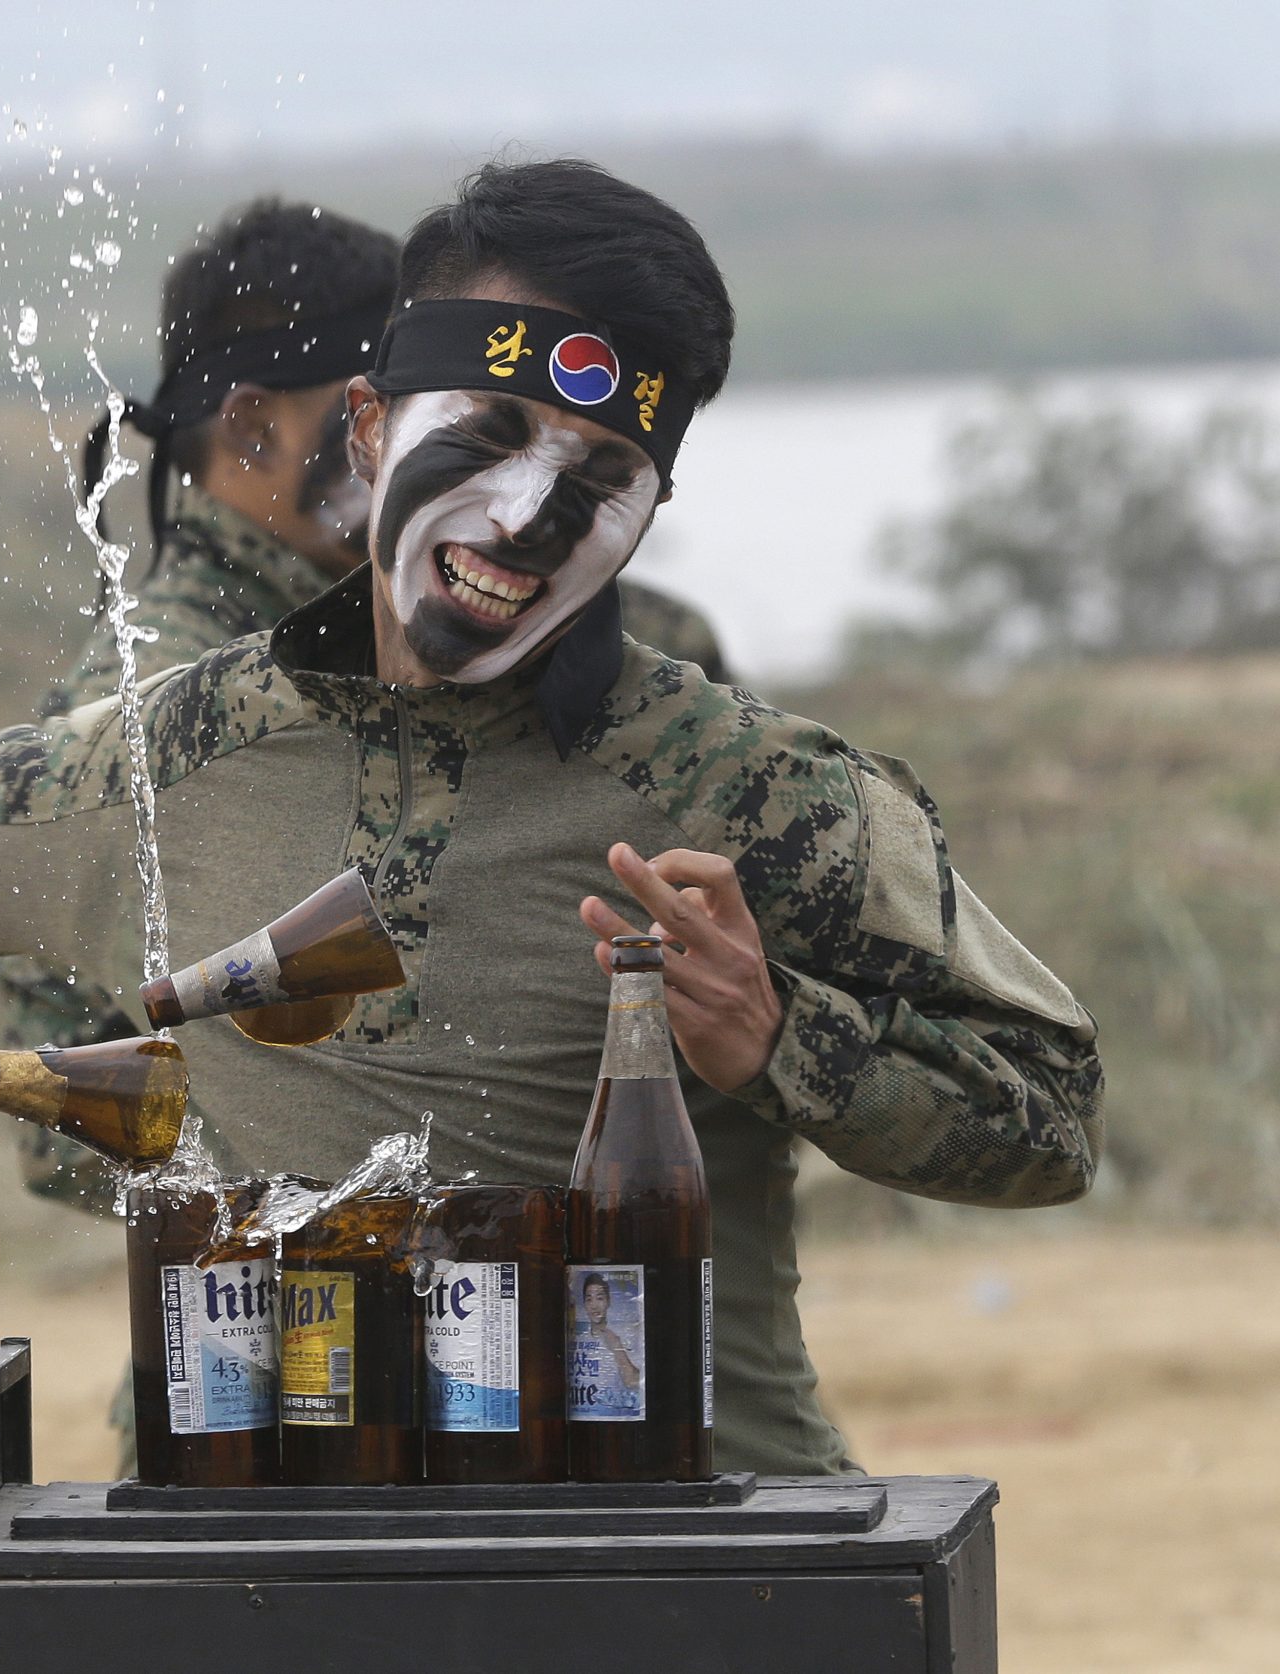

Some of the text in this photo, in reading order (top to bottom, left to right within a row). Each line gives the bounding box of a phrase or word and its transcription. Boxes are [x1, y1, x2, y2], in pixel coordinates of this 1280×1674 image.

[167, 1293, 179, 1308] 미만
[425, 1276, 476, 1320] ite
[222, 1326, 255, 1338] EXTRA
[435, 1327, 460, 1337] COLD
[211, 1357, 249, 1382] 4.3%
[445, 1361, 475, 1370] POINT
[211, 1384, 251, 1395] EXTRA
[438, 1383, 475, 1402] 1933
